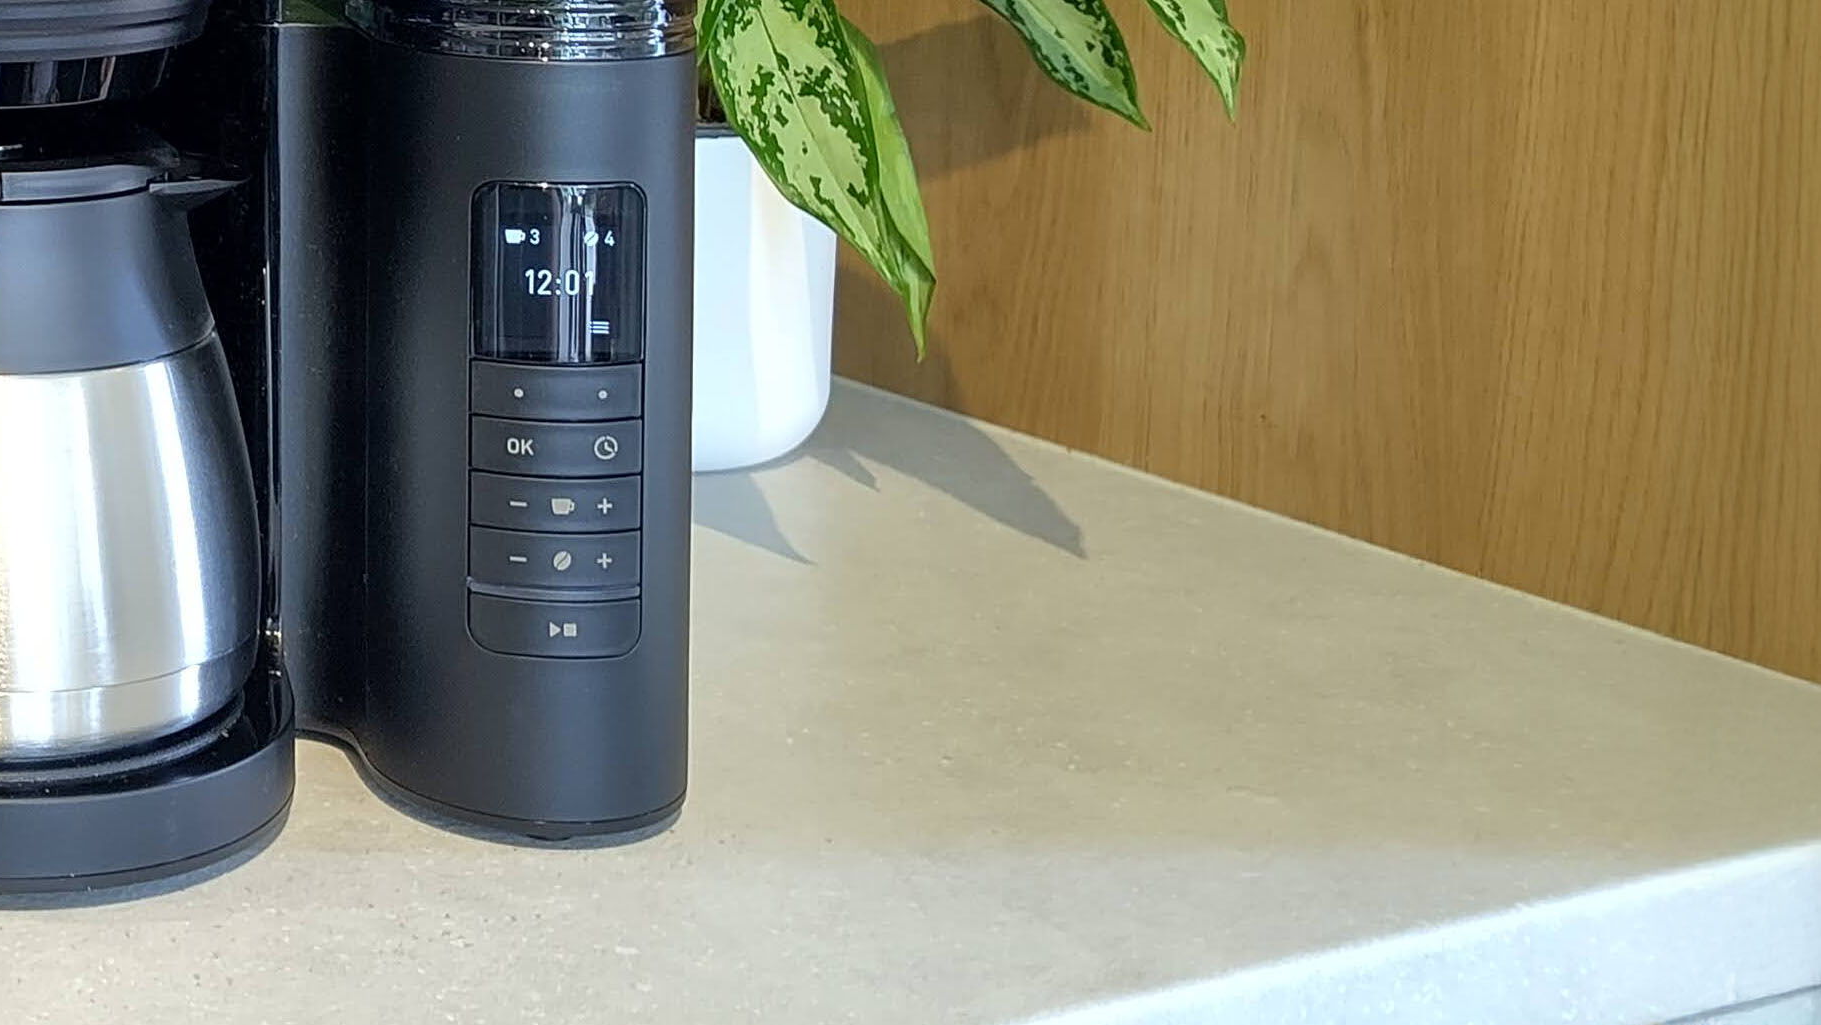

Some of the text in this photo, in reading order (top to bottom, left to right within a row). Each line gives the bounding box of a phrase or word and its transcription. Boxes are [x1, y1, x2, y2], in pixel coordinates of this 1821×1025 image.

[529, 228, 540, 245] 3
[604, 230, 615, 247] 4
[525, 269, 594, 296] 12:01
[507, 438, 534, 456] OK
